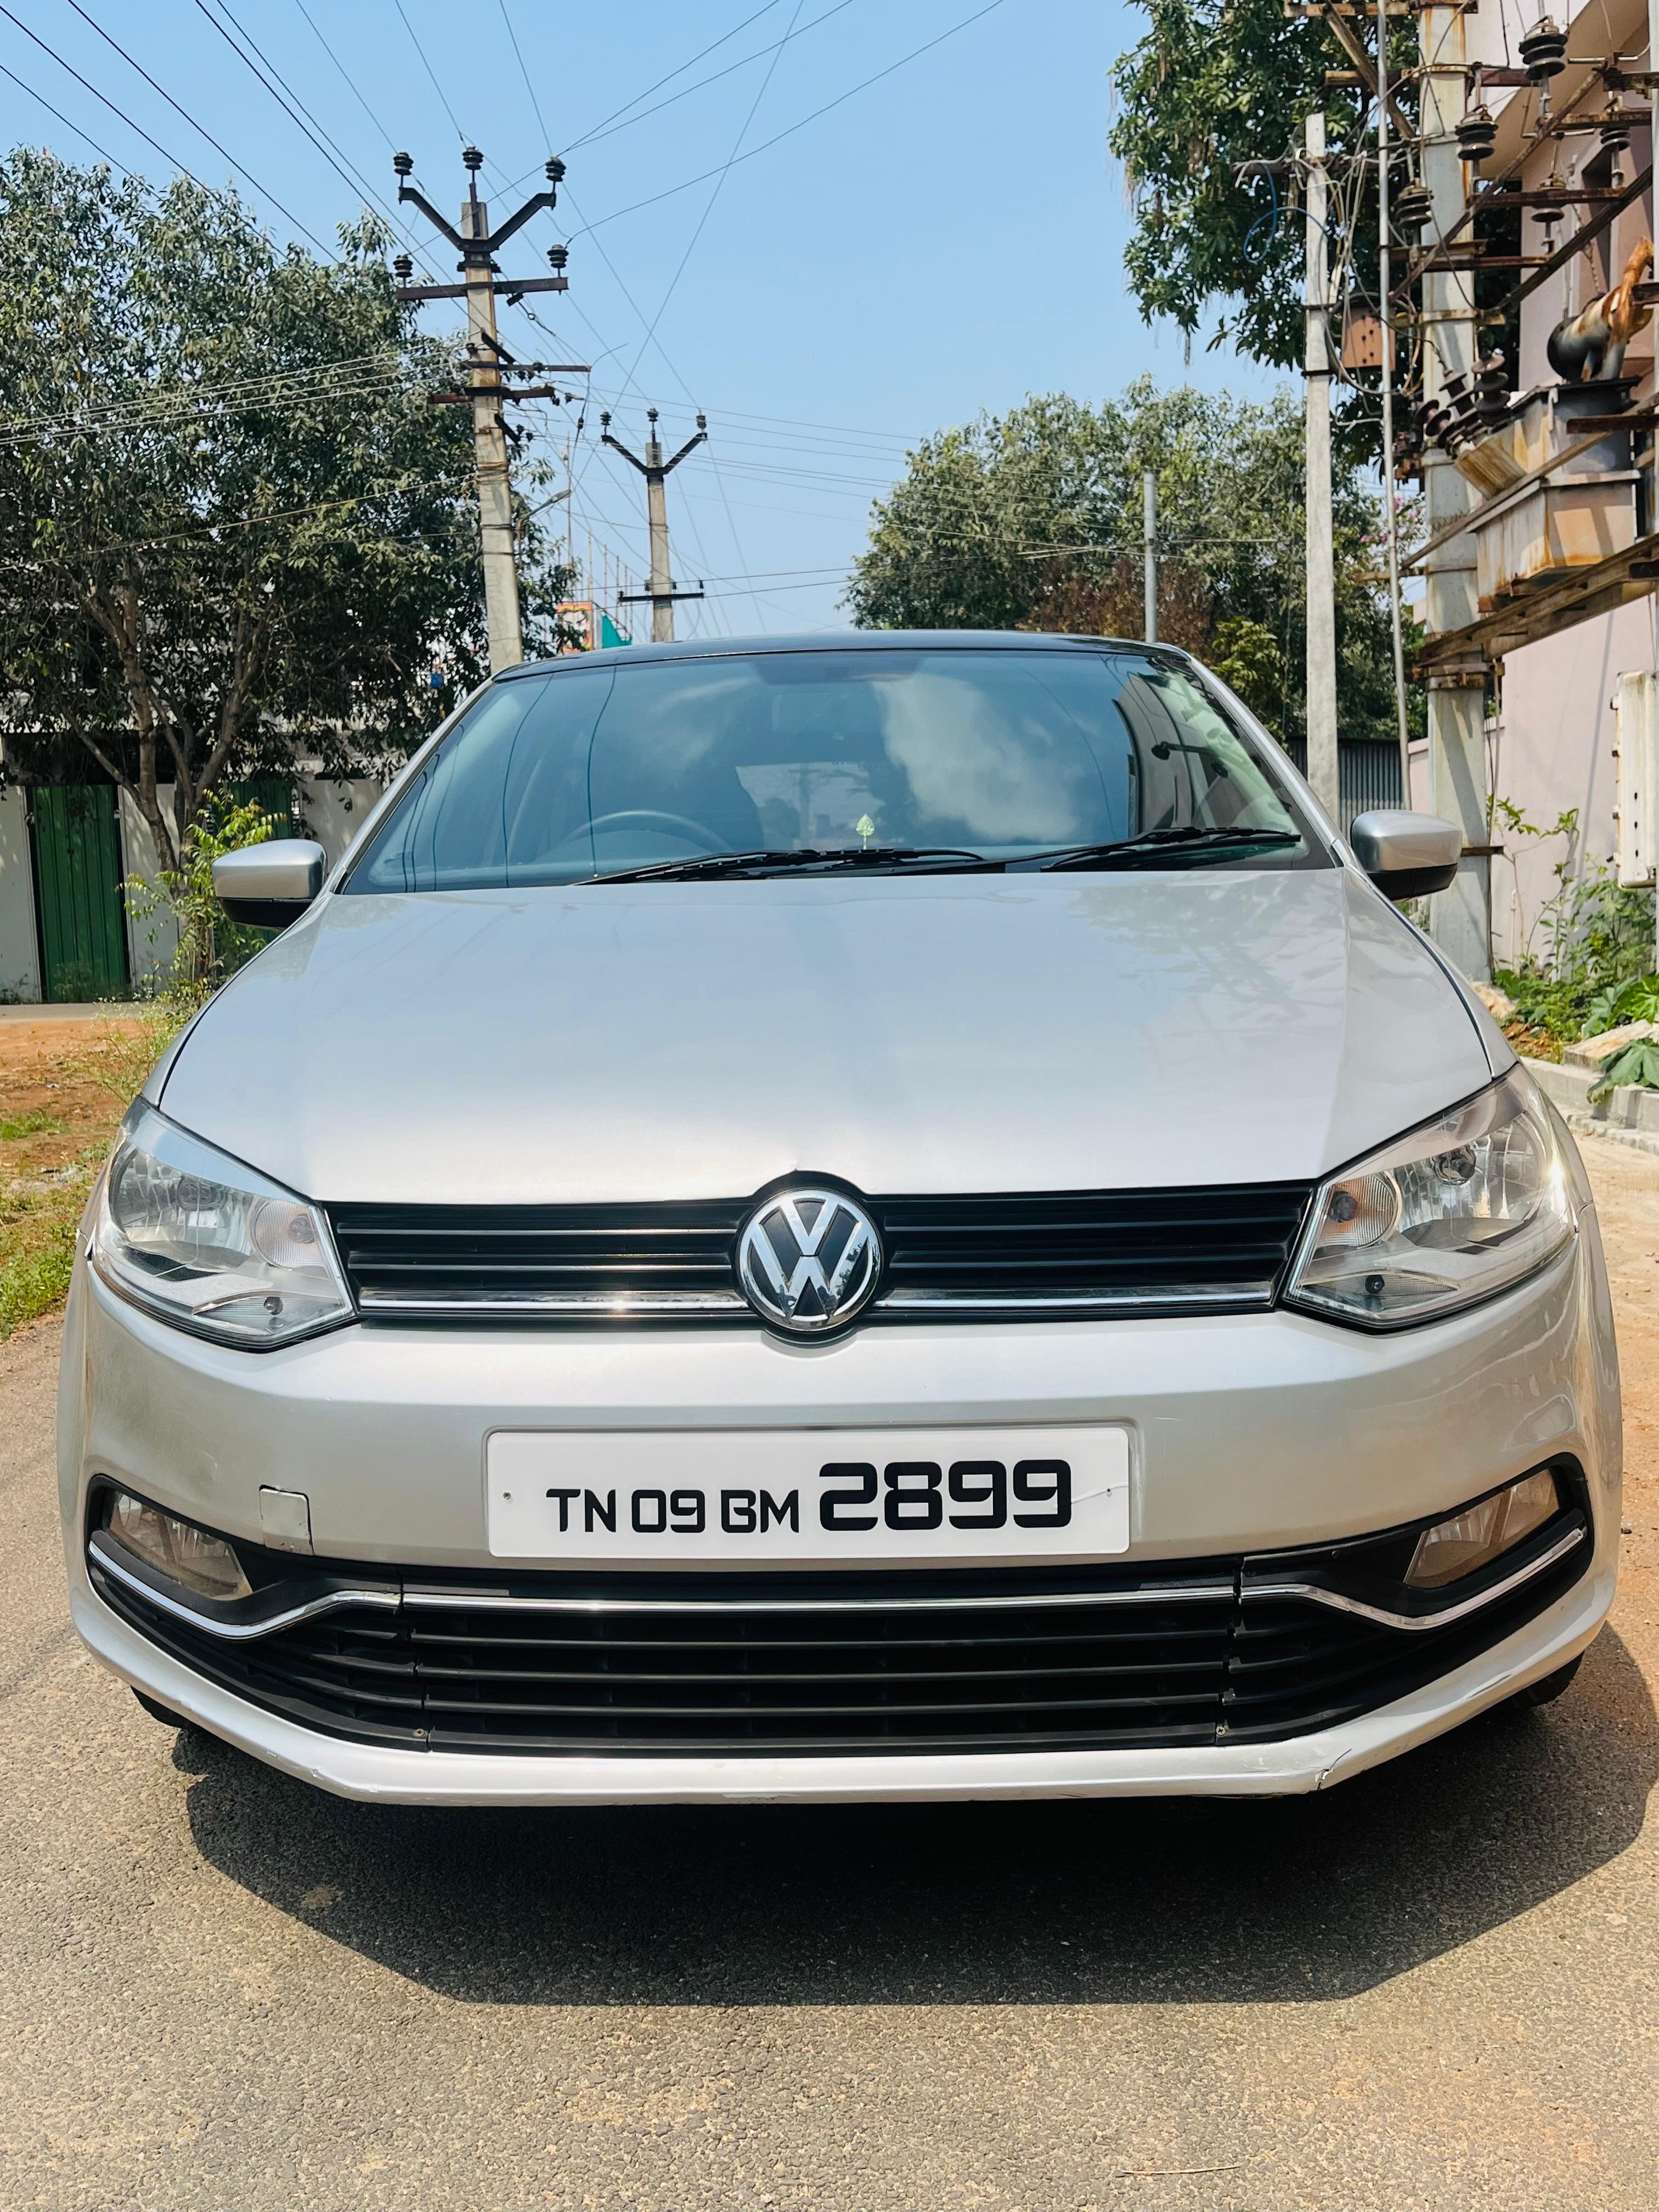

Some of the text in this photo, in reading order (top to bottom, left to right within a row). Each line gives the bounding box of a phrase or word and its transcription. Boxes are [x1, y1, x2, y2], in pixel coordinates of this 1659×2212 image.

[741, 1190, 881, 1331] VW
[546, 1459, 1072, 1533] TN 09 BM 2899
